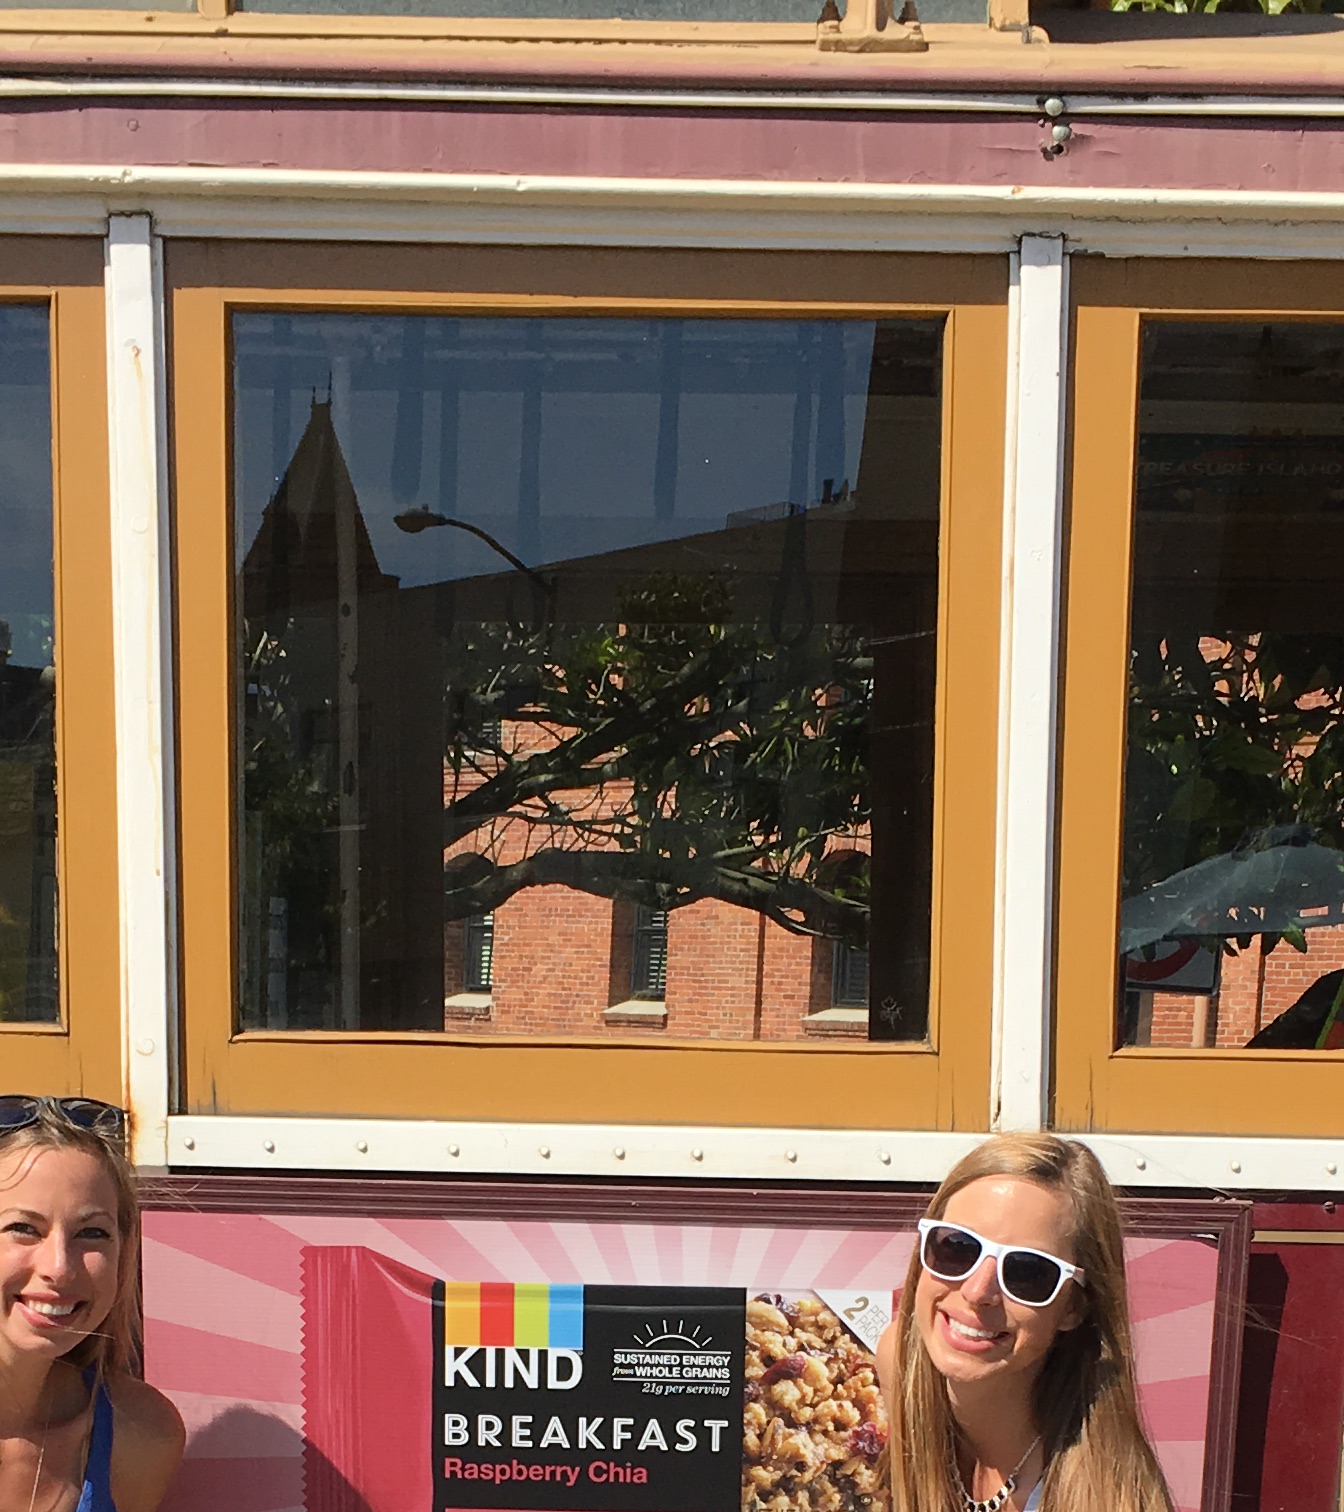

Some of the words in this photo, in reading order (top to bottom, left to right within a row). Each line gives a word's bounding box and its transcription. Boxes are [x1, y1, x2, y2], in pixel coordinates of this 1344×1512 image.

[843, 1296, 869, 1321] 2
[866, 1305, 889, 1328] PER
[444, 1346, 584, 1390] KIND
[613, 1353, 680, 1365] SUSTAINED
[682, 1355, 731, 1366] ENERGY
[612, 1366, 634, 1376] from
[634, 1366, 681, 1377] WHOLE
[682, 1367, 730, 1379] GRAINS
[641, 1382, 663, 1395] 21g
[664, 1384, 685, 1395] per
[686, 1383, 730, 1396] serving
[444, 1413, 729, 1452] BREAKFAST
[444, 1457, 581, 1486] Raspberry
[588, 1460, 649, 1485] Chia
